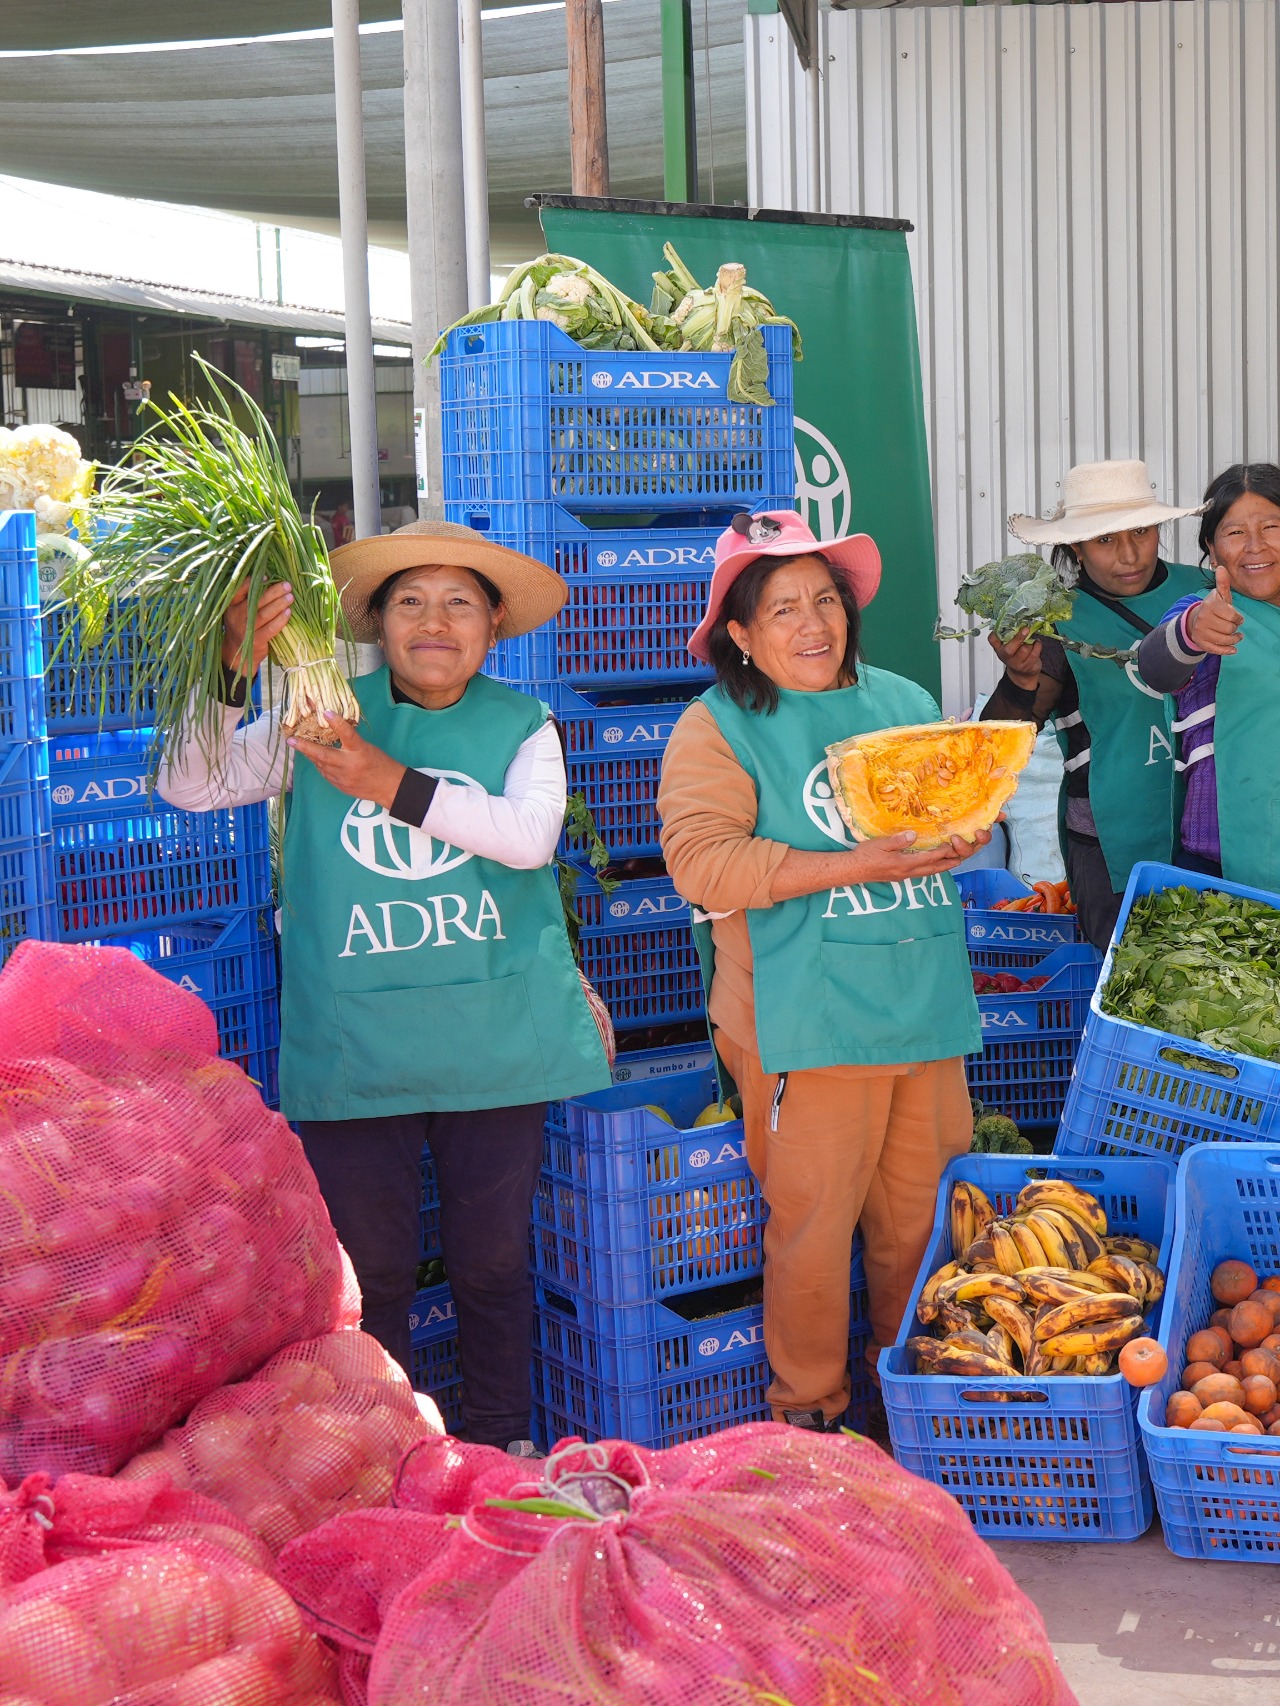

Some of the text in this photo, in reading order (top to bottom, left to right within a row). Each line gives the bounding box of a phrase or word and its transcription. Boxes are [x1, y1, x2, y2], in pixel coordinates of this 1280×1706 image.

[614, 371, 720, 388] ADRA
[625, 723, 676, 742] AD
[821, 871, 952, 918] ADRA
[632, 895, 691, 915] AD
[338, 890, 506, 958] ADRA
[987, 926, 1067, 943] ADRA
[979, 1011, 1028, 1028] RA
[649, 1060, 696, 1074] Rumbo al
